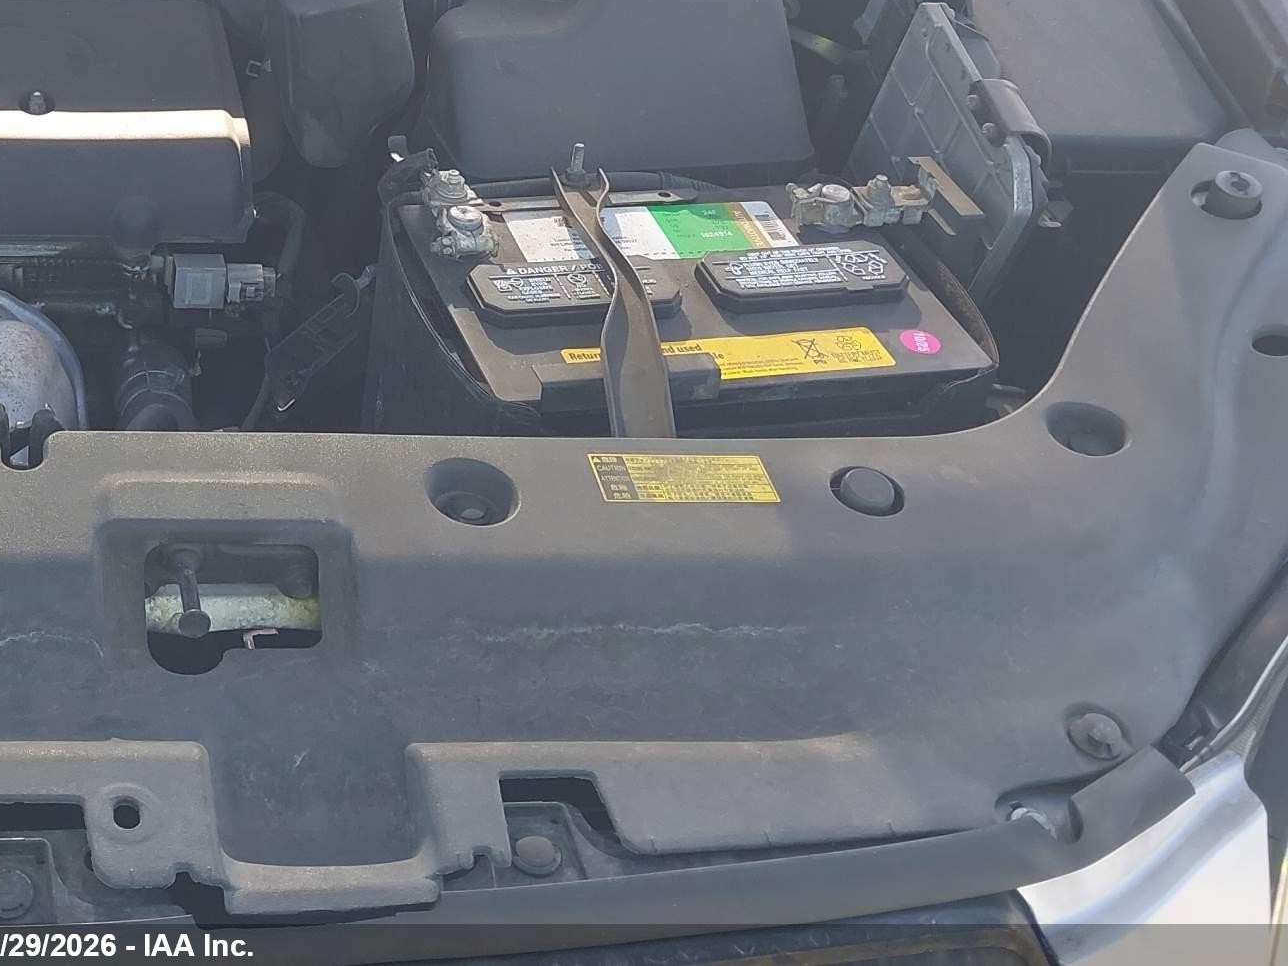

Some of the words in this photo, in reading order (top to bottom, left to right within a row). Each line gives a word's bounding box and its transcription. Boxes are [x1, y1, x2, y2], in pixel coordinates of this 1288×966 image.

[518, 265, 569, 275] DANGER
[661, 344, 675, 354] nd
[677, 343, 703, 353] used
